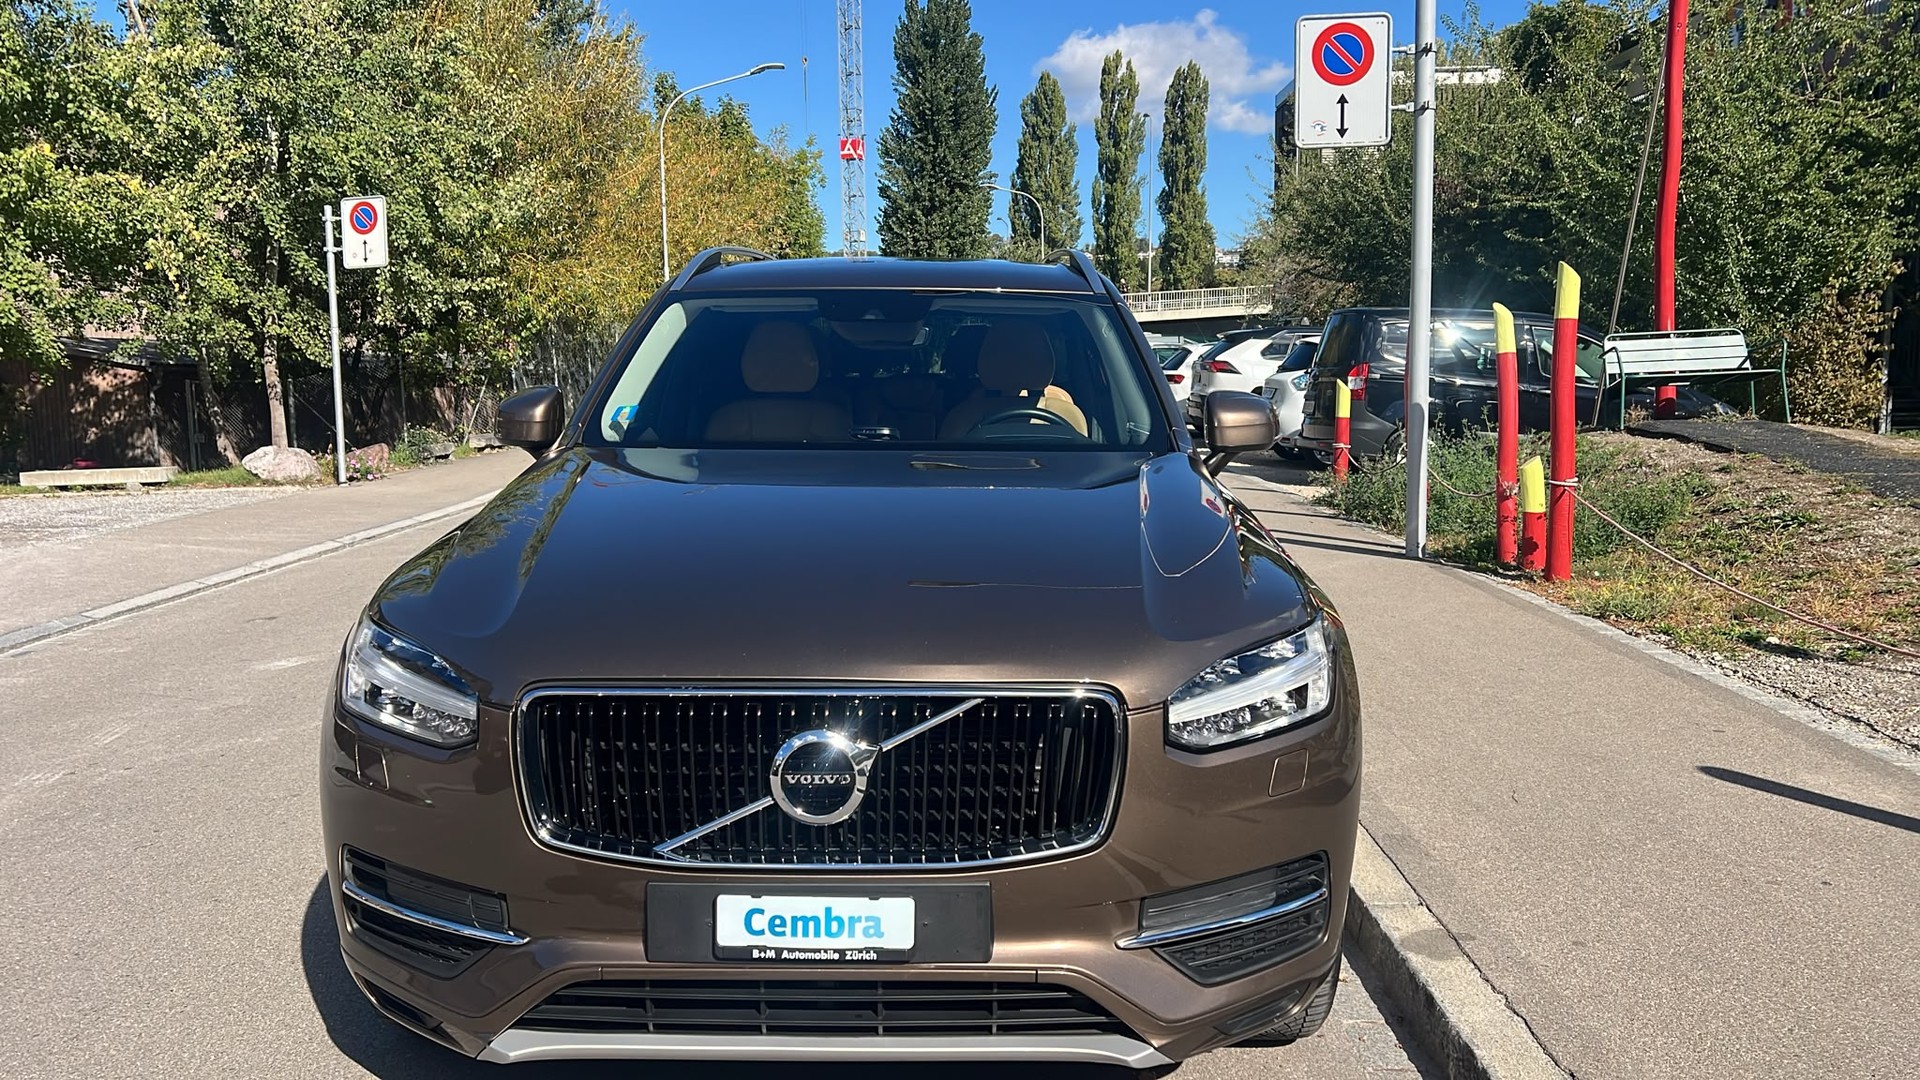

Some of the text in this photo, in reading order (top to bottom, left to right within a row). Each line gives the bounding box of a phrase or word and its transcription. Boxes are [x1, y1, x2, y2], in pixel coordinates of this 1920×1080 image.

[784, 774, 851, 785] VOLVO
[743, 906, 884, 939] Cembra
[752, 949, 877, 960] B+M Automobile Zürich
